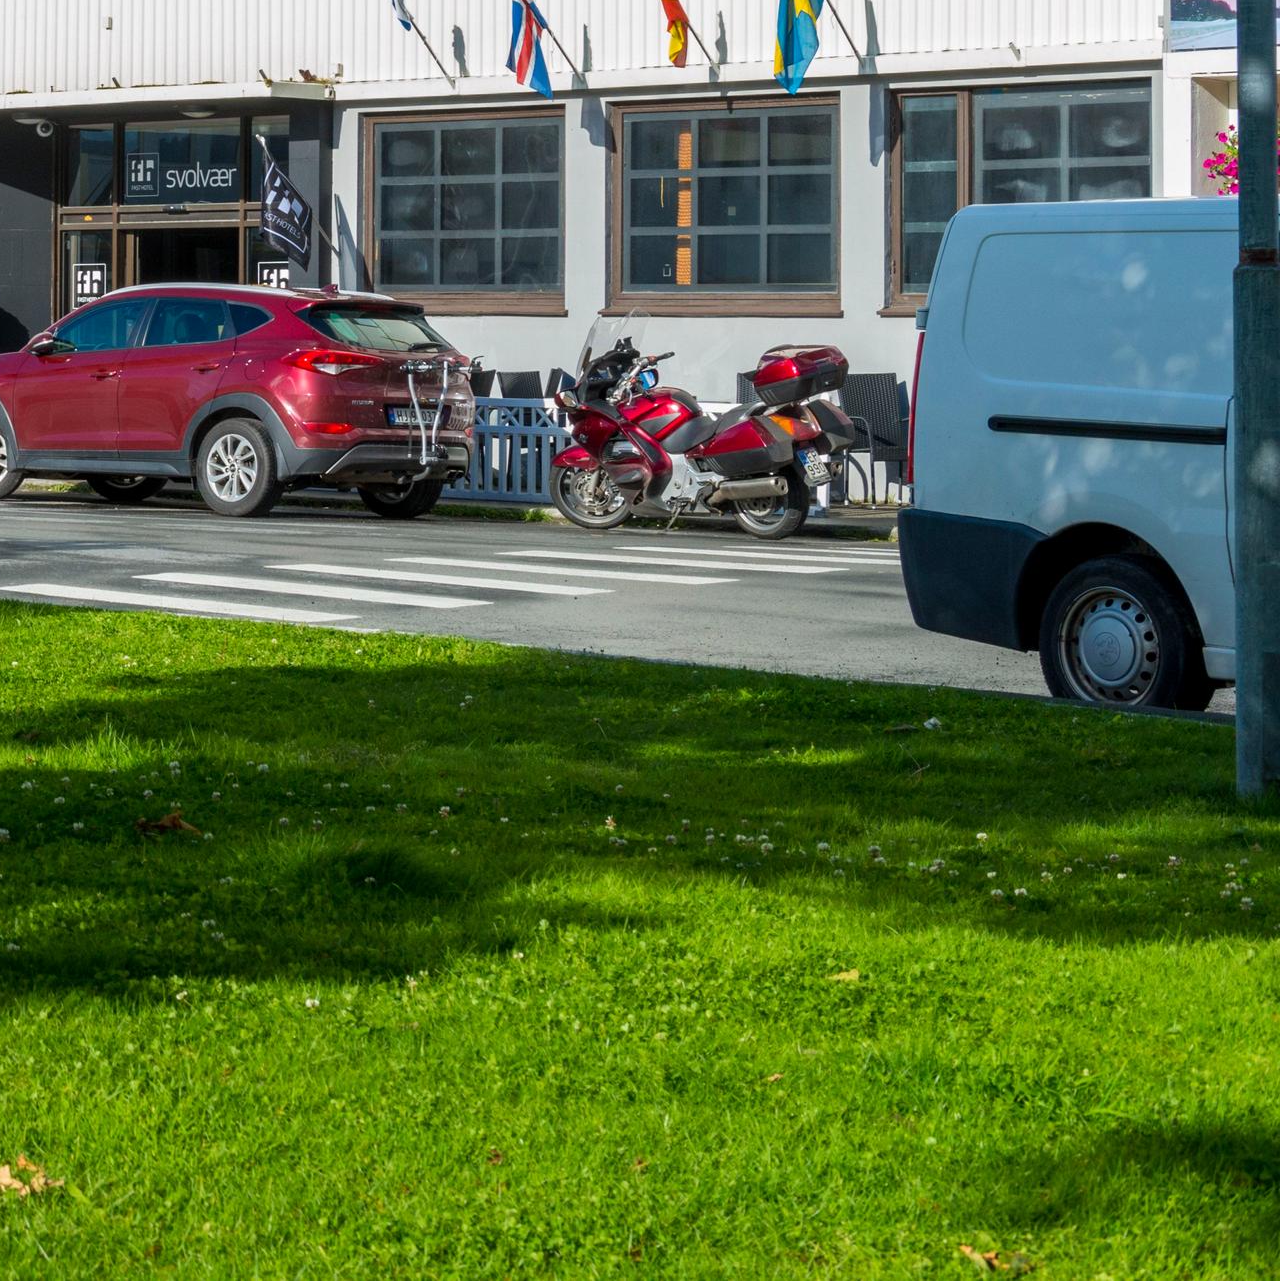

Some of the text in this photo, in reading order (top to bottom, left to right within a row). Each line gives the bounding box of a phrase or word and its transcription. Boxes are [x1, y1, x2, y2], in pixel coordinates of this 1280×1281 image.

[166, 161, 237, 188] svolvær
[410, 410, 437, 422] 9037
[807, 462, 826, 475] 990
